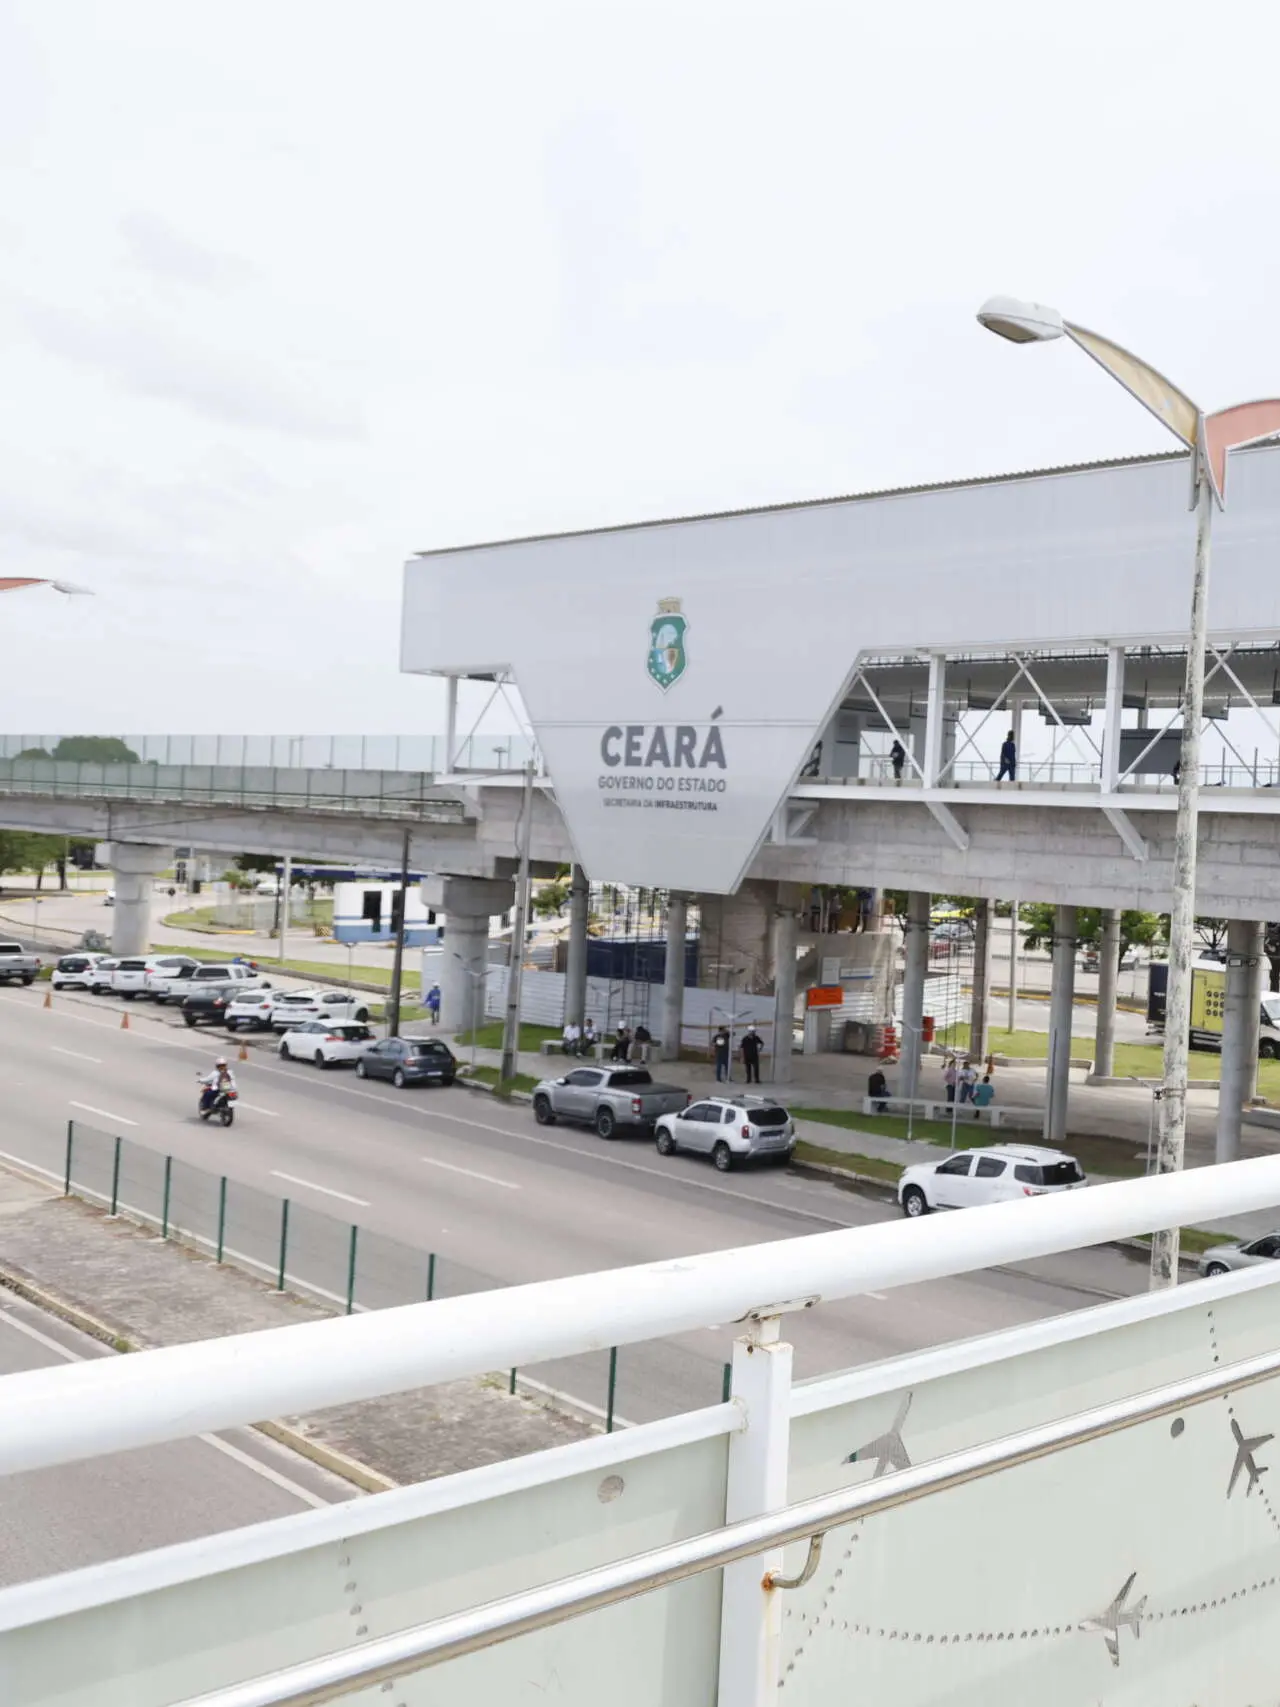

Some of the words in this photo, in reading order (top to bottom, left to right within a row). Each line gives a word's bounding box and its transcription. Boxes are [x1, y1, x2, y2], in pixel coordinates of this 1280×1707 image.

[601, 705, 727, 769] CEARÁ
[598, 775, 654, 791] GOVERNO
[656, 777, 675, 791] DO
[678, 777, 727, 793] ESTADO
